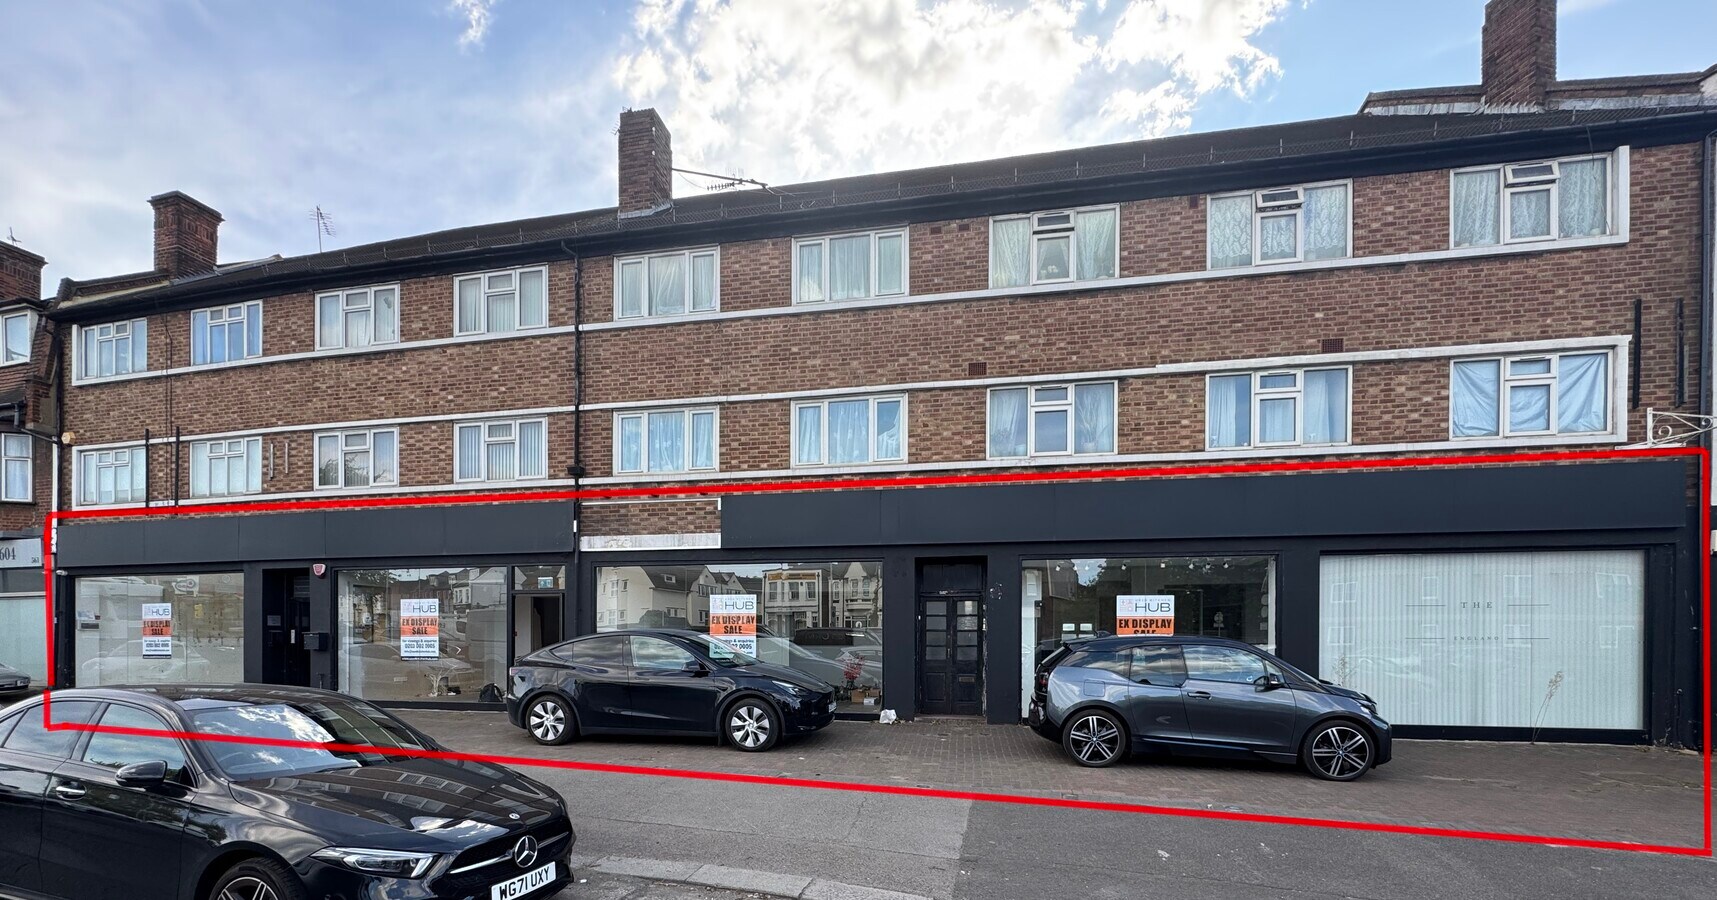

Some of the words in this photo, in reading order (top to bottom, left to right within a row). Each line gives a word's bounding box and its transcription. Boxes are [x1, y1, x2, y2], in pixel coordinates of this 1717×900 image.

[412, 604, 437, 613] HUB
[725, 601, 755, 610] HUB
[1135, 602, 1171, 613] HUB
[1460, 601, 1493, 609] THE
[151, 608, 170, 616] HUB
[150, 620, 171, 628] DISPLAY
[402, 618, 410, 626] EX
[411, 617, 438, 626] DISPLAY
[712, 615, 721, 625] EX
[722, 615, 756, 625] DISPLAY
[1119, 619, 1130, 629] EX
[1132, 619, 1172, 629] DISPLAY
[151, 628, 164, 636] SALE
[412, 626, 428, 635] SALE
[724, 625, 743, 634] SALE
[499, 876, 528, 900] WG71
[530, 866, 550, 888] UXY
